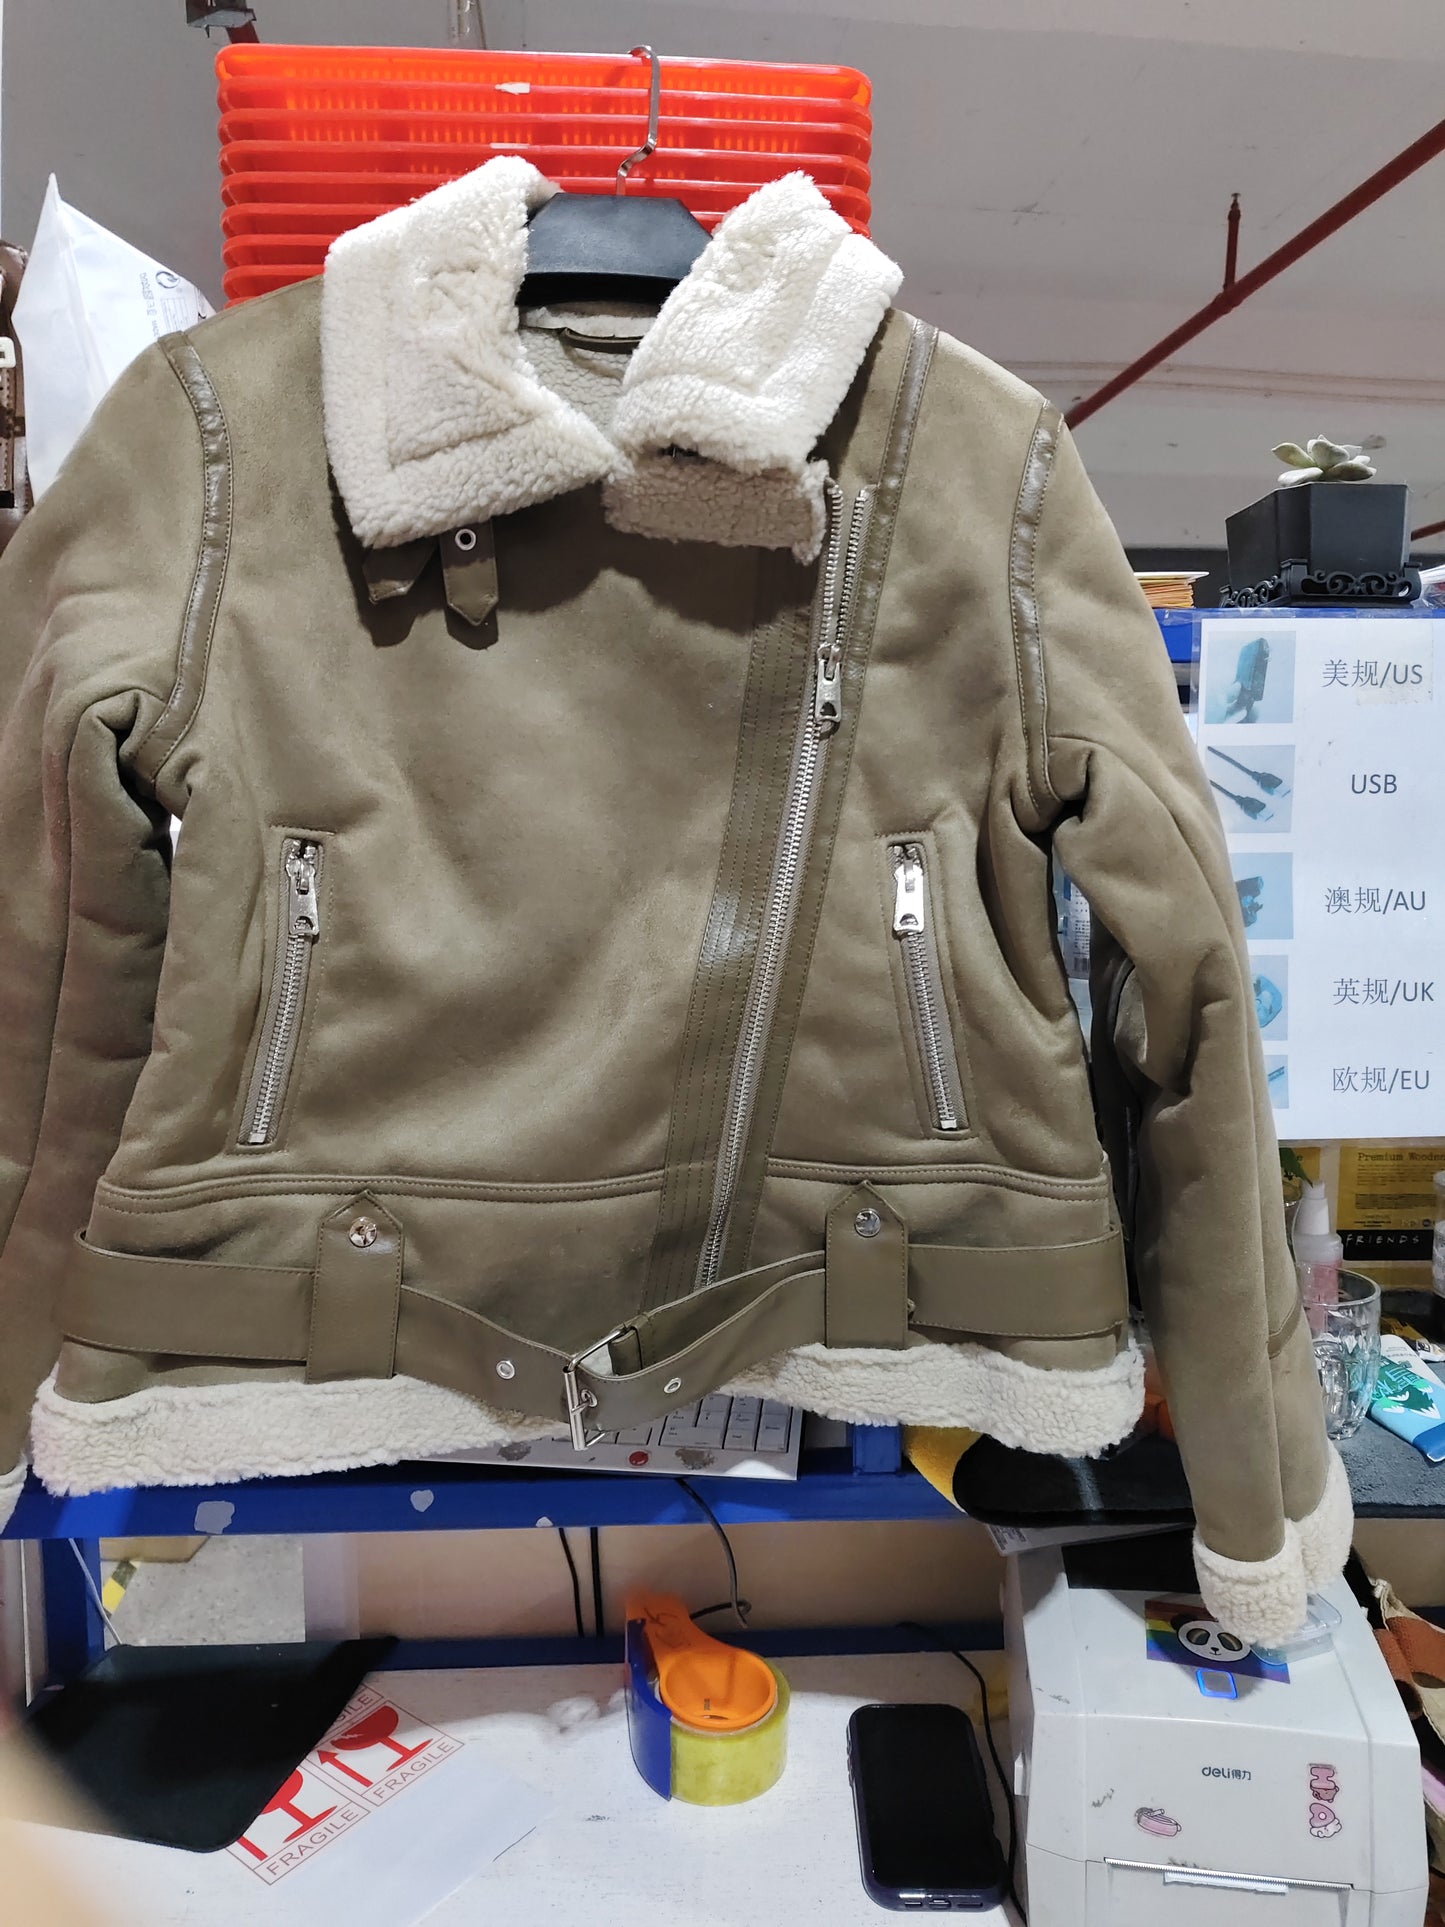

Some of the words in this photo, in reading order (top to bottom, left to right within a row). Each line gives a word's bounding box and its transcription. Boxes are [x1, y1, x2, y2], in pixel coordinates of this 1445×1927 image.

[1321, 659, 1423, 688] 美规/US
[1351, 774, 1398, 794] USB
[1324, 886, 1426, 915] 澳规/AU
[1332, 977, 1434, 1006] 英规/UK
[1332, 1066, 1430, 1094] 欧规/EU
[1358, 1152, 1404, 1161] Premium
[1346, 1233, 1420, 1248] FRIENDS
[373, 1741, 455, 1799] FRAGILE
[266, 1809, 359, 1876] FRAGILE
